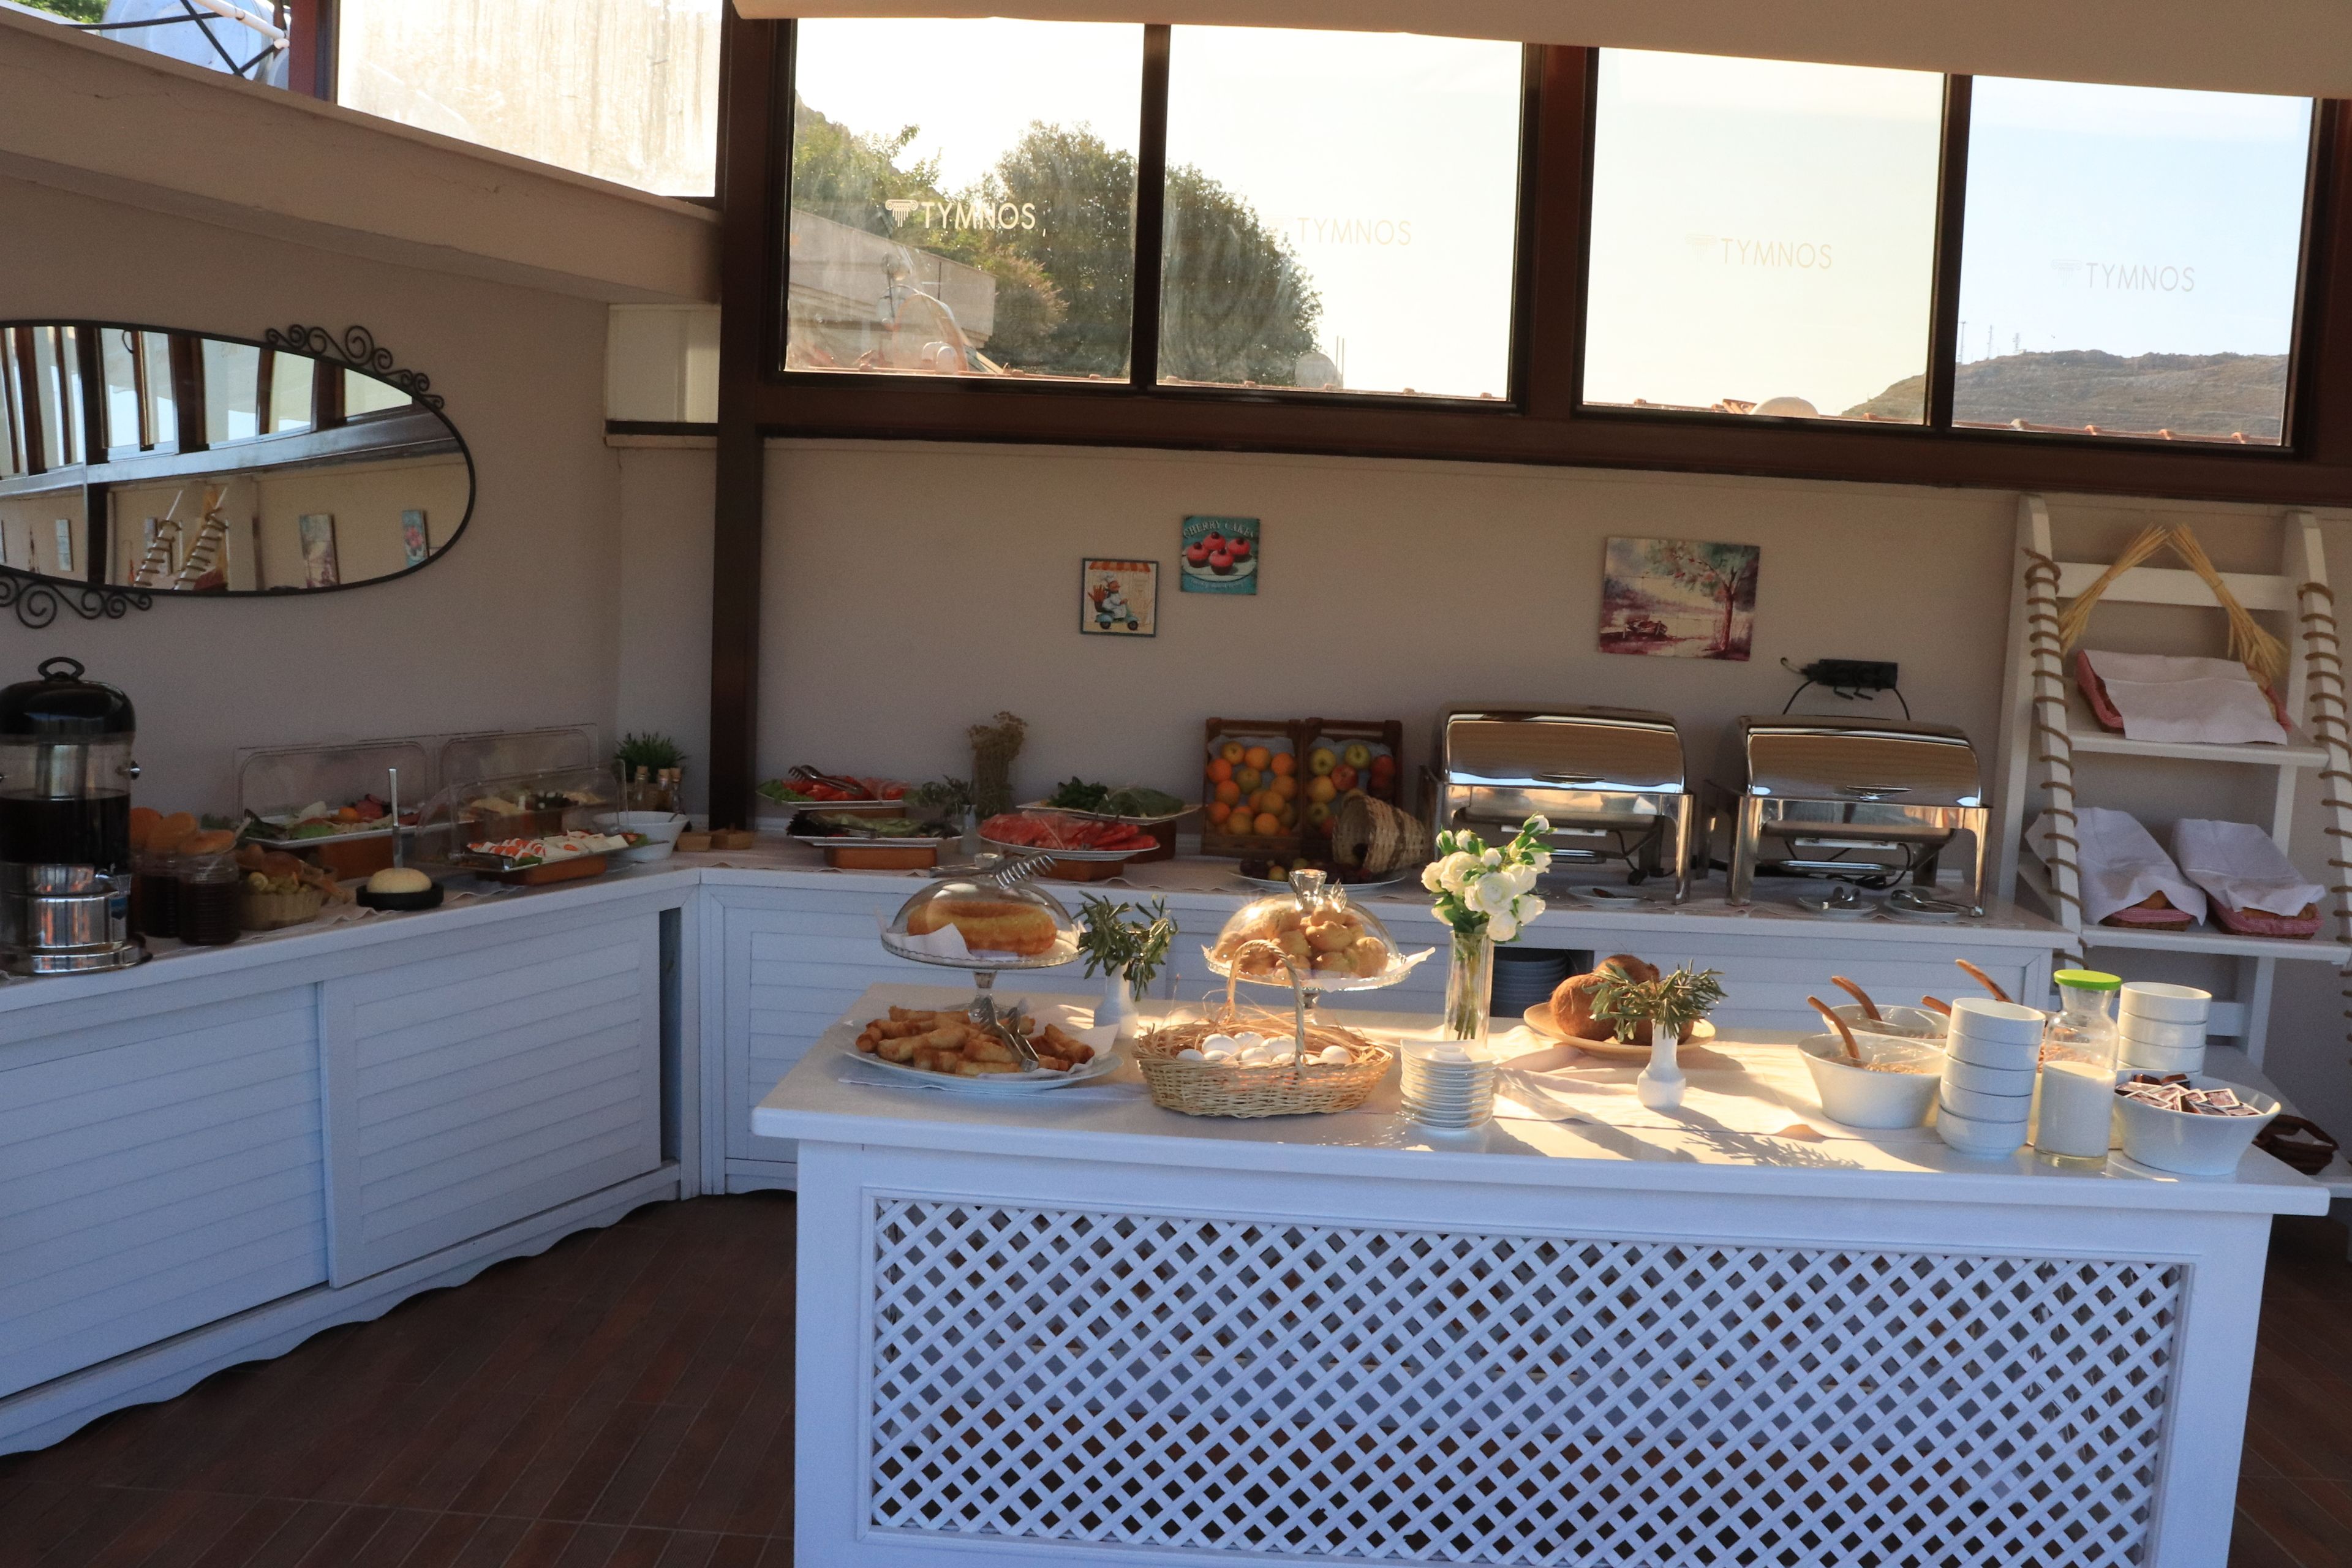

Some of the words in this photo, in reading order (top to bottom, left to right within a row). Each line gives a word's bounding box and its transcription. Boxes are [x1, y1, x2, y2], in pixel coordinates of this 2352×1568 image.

[921, 202, 1036, 230] TYMNOS
[1297, 217, 1412, 246] TYMNOS
[1720, 238, 1832, 270] TYMNOS
[2086, 262, 2195, 292] TYMNOS
[1183, 520, 1221, 539] CHERRY
